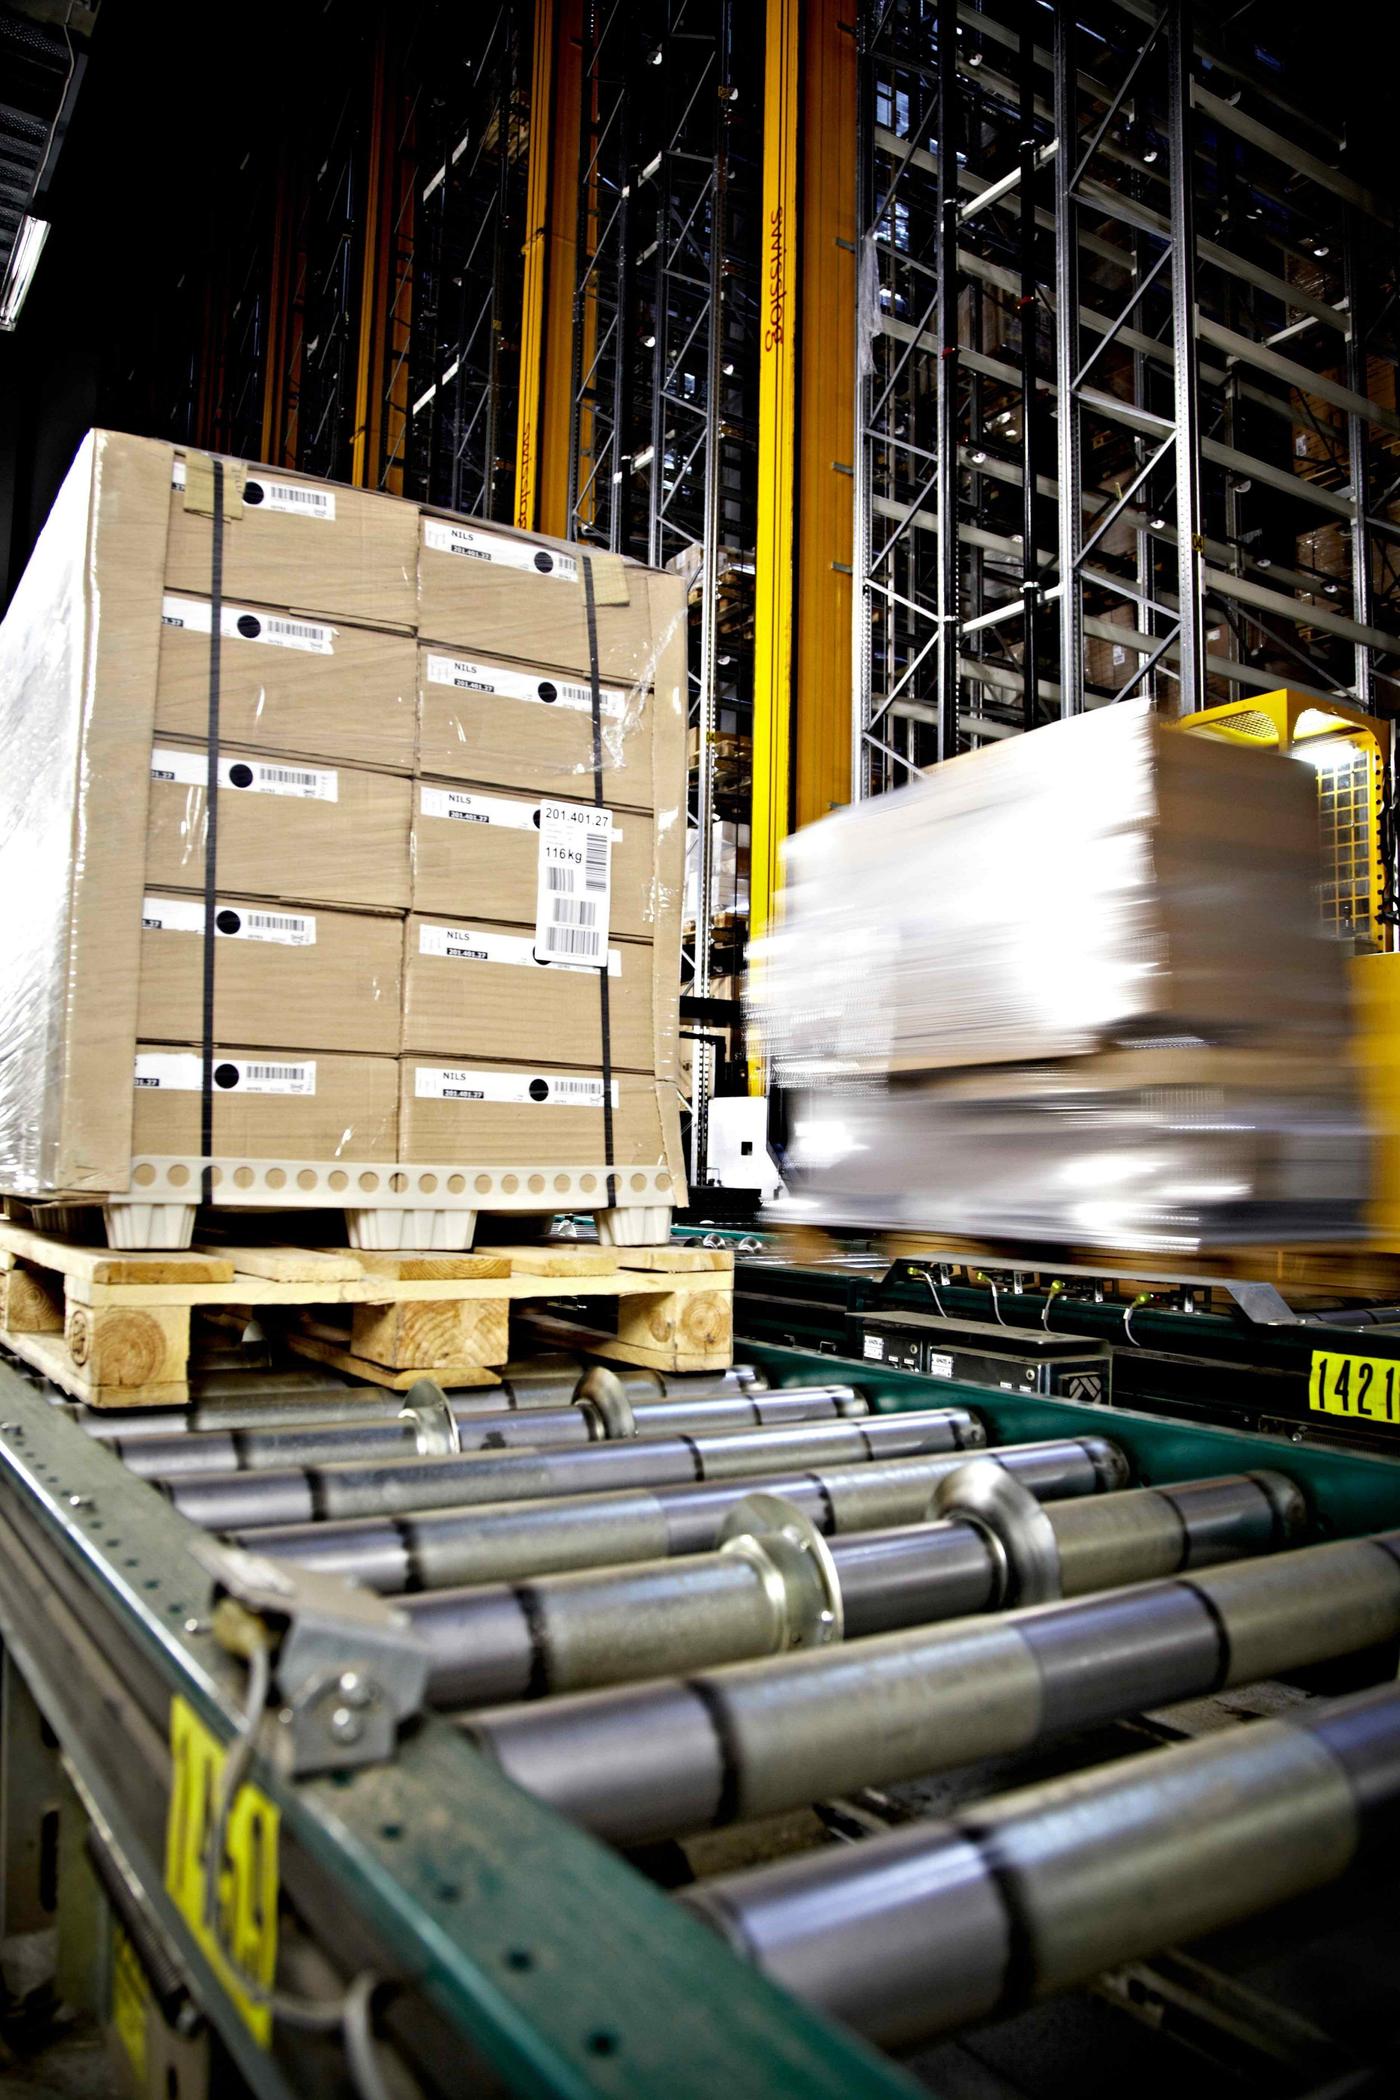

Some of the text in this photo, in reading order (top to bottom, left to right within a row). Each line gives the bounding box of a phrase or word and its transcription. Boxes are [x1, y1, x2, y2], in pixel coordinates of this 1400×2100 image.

[451, 530, 474, 541] NILS
[454, 662, 477, 674] NILS
[448, 794, 472, 805] NILS
[546, 807, 609, 827] 201.401.27
[447, 931, 470, 941] NILS
[443, 1072, 467, 1081] NILS
[1318, 1358, 1395, 1420] 1421
